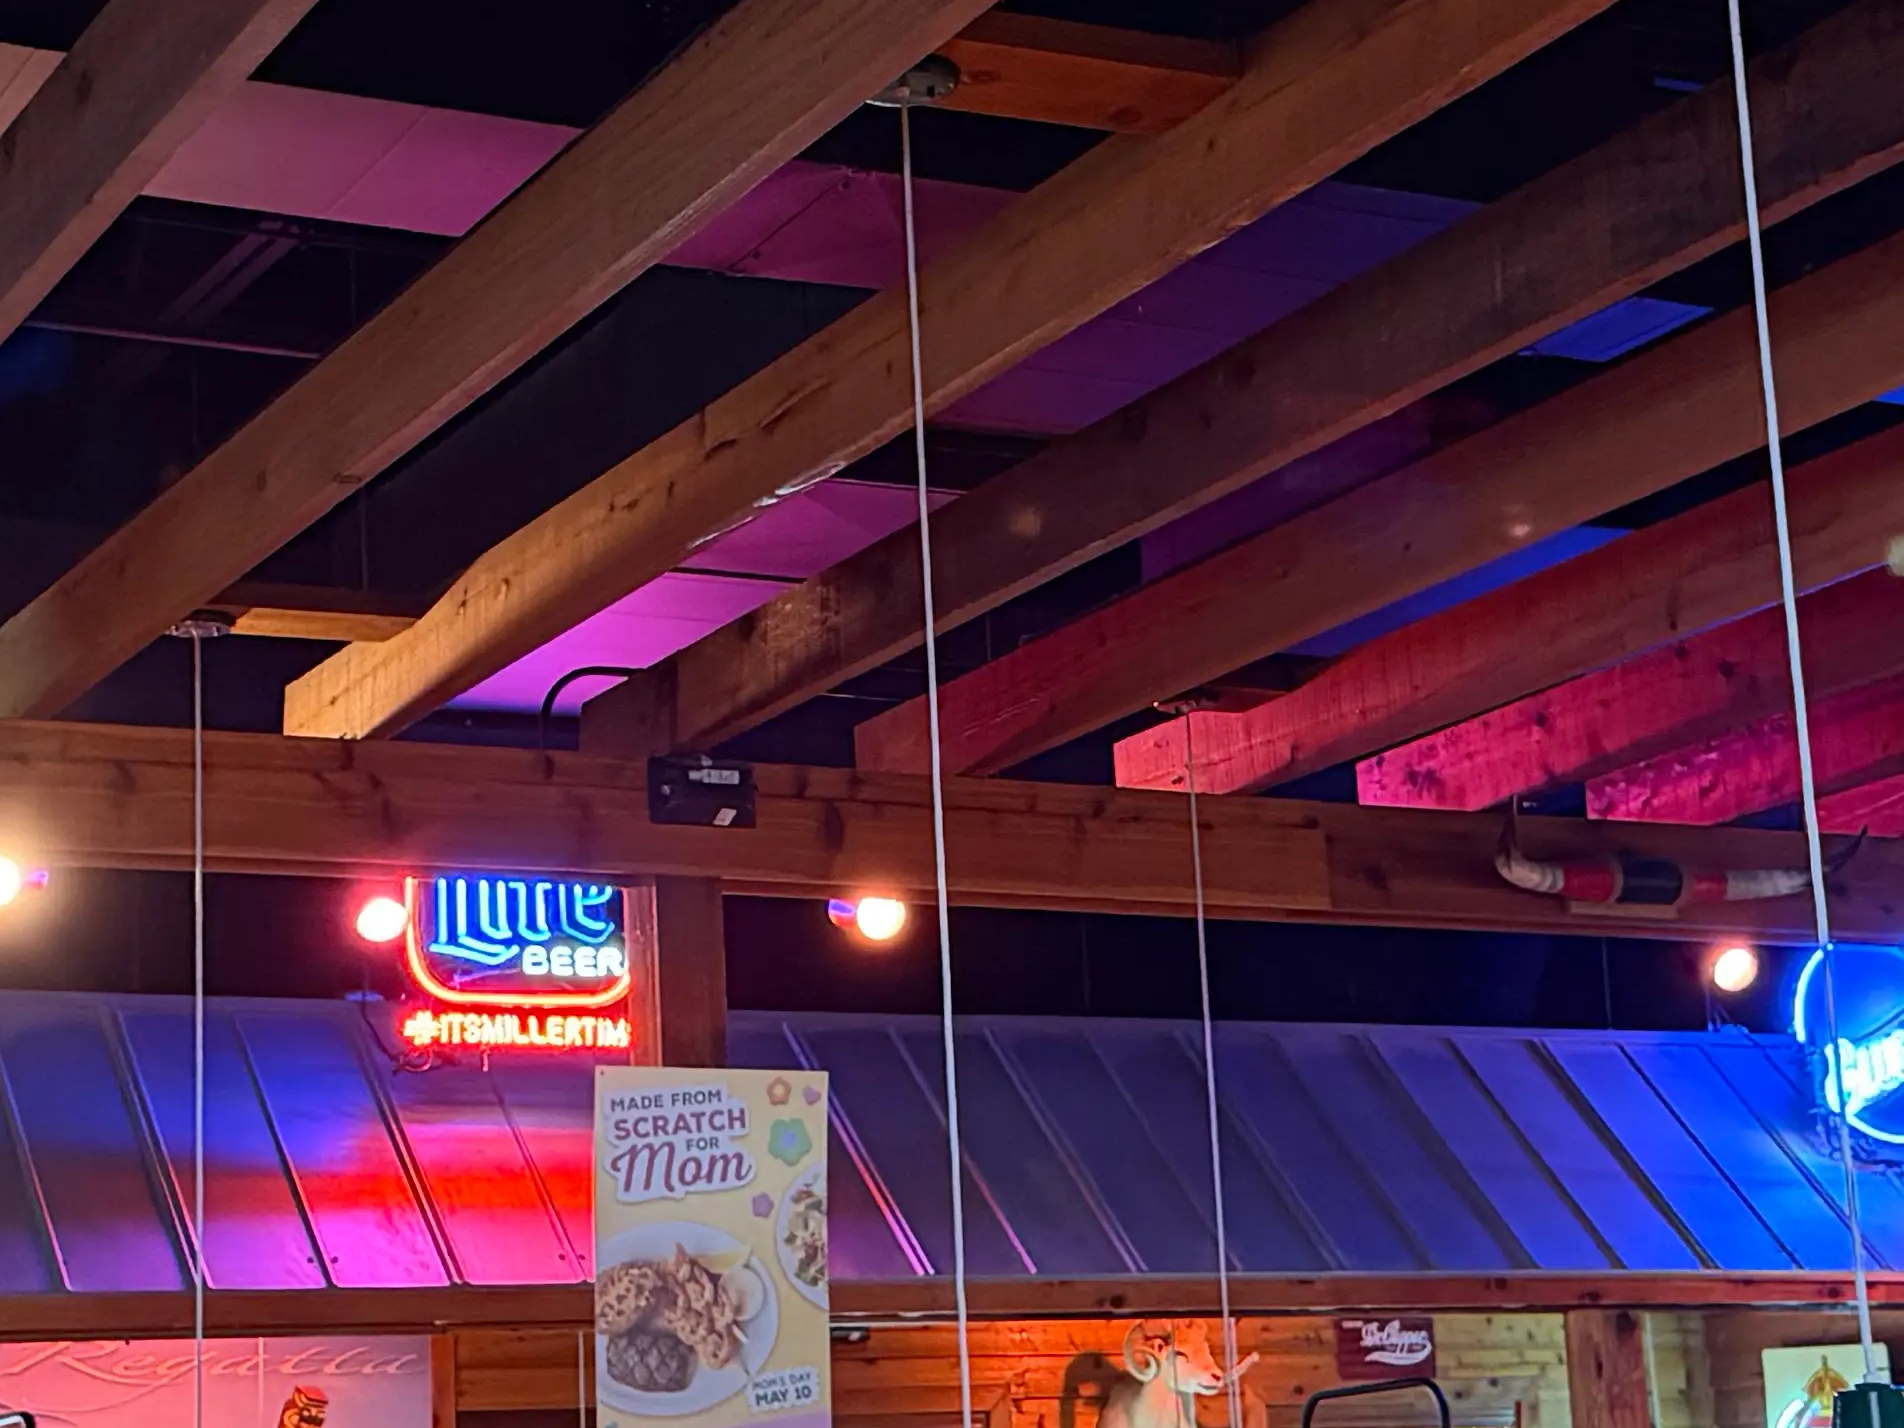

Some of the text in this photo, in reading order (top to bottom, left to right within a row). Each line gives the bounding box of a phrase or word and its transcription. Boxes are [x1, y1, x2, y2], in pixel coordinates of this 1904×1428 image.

[522, 943, 629, 977] BEER
[403, 1009, 630, 1047] #ITSMILLERTIM
[610, 1089, 722, 1113] MADE FROM
[613, 1108, 746, 1141] SCRATCH
[685, 1137, 720, 1152] FOR
[610, 1141, 753, 1193] Mom
[755, 1384, 812, 1406] MAY 10
